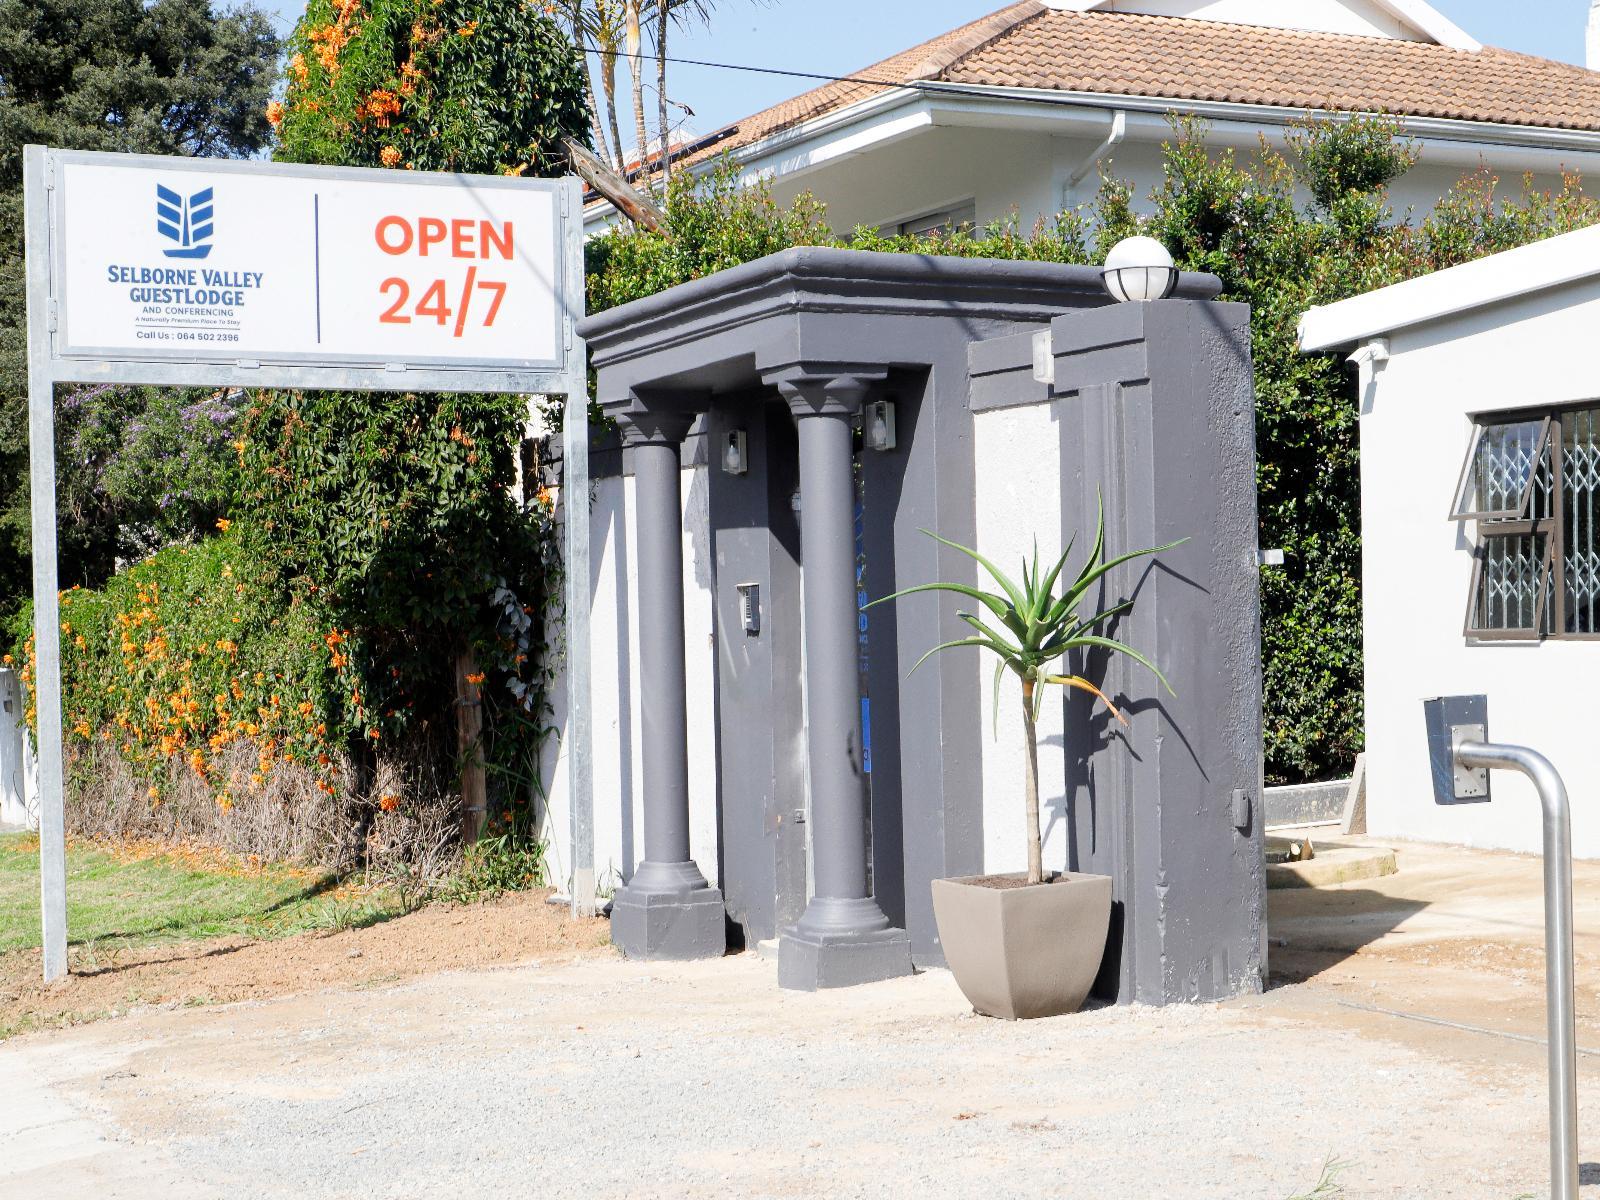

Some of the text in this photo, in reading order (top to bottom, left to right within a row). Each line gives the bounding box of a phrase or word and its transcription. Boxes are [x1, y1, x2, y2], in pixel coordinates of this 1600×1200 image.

[375, 215, 514, 260] OPEN
[108, 265, 263, 288] SELBORNE VALLEY
[130, 288, 245, 306] GUESTLODGE
[379, 266, 507, 337] 24/7
[140, 316, 171, 324] Naturally
[142, 306, 235, 317] AND CONFERENCING
[136, 330, 156, 339] Call
[157, 331, 170, 340] Us
